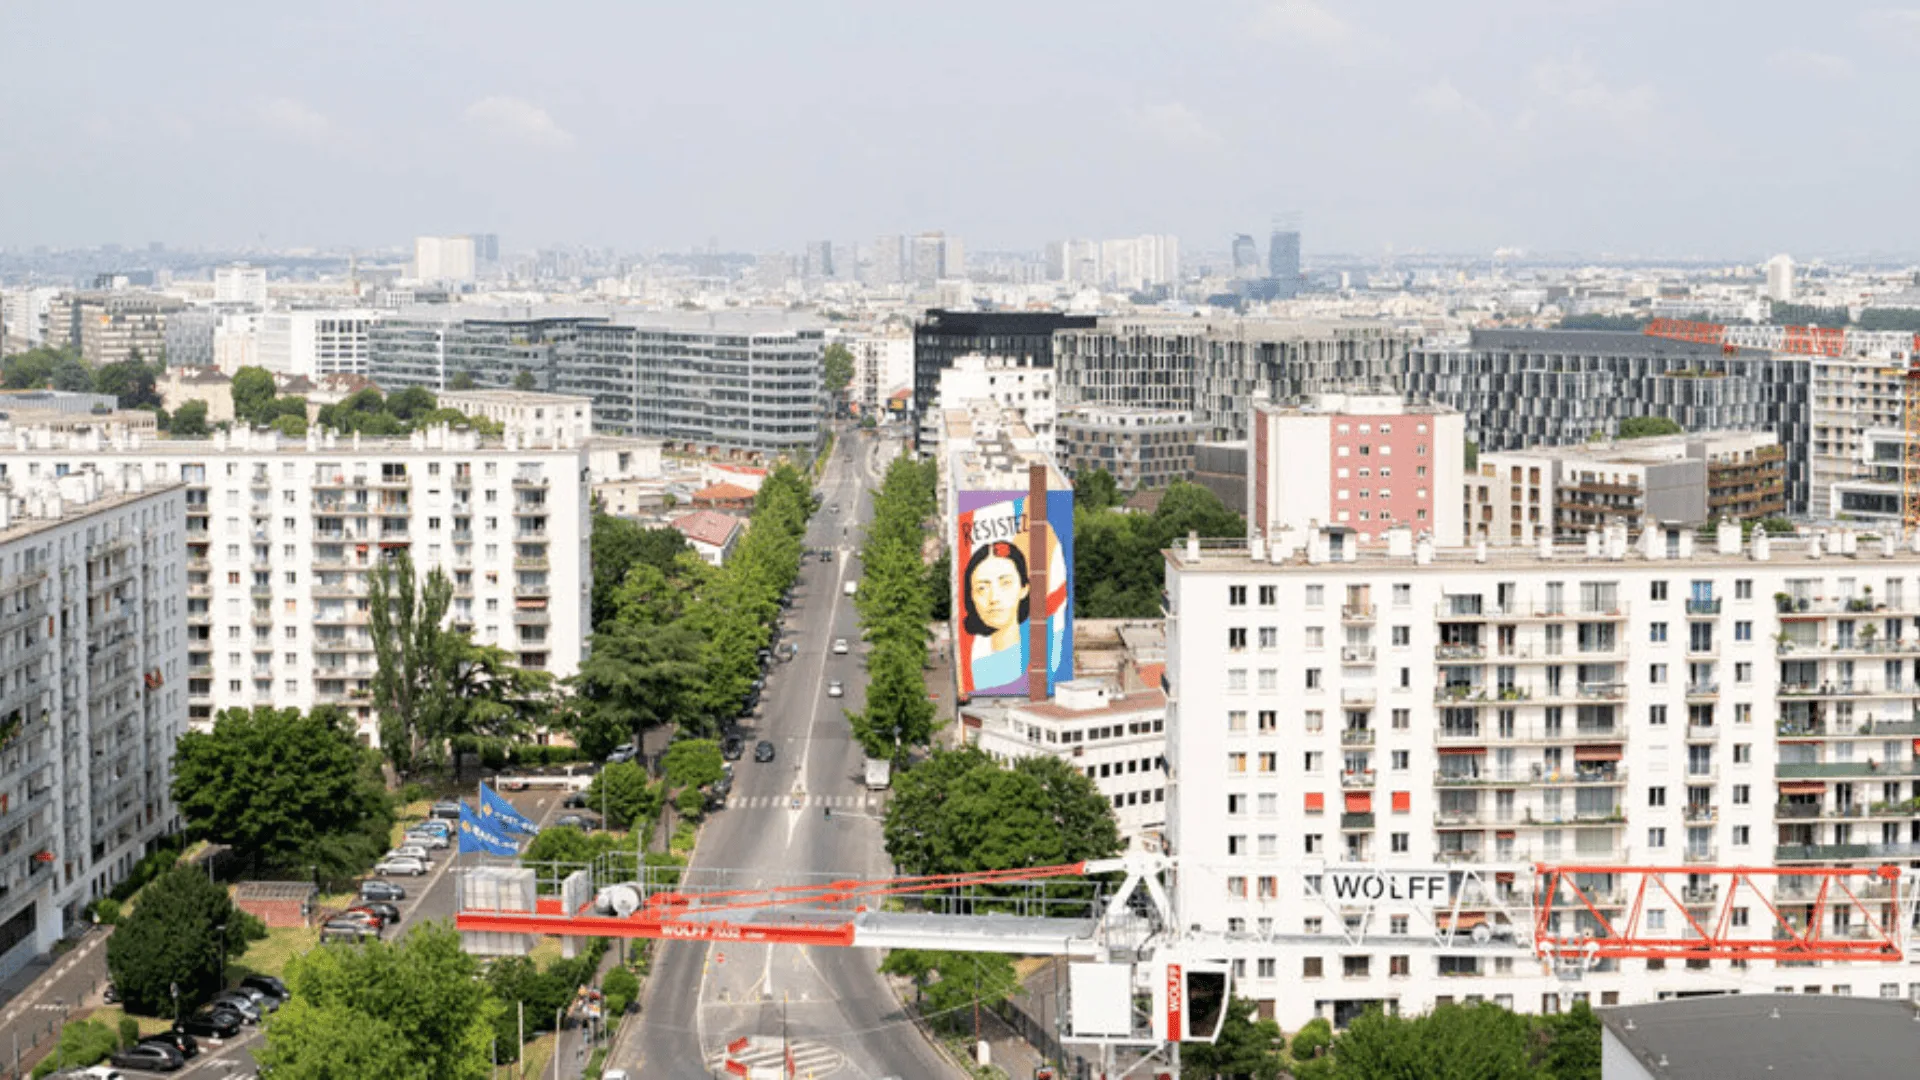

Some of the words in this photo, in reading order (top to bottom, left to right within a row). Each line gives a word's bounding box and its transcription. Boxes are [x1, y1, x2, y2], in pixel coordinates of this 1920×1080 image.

[962, 514, 1030, 546] RESISTEZ
[1333, 875, 1445, 899] WOLFF
[662, 925, 707, 937] WOLFF
[1168, 964, 1181, 1011] WOLFF
